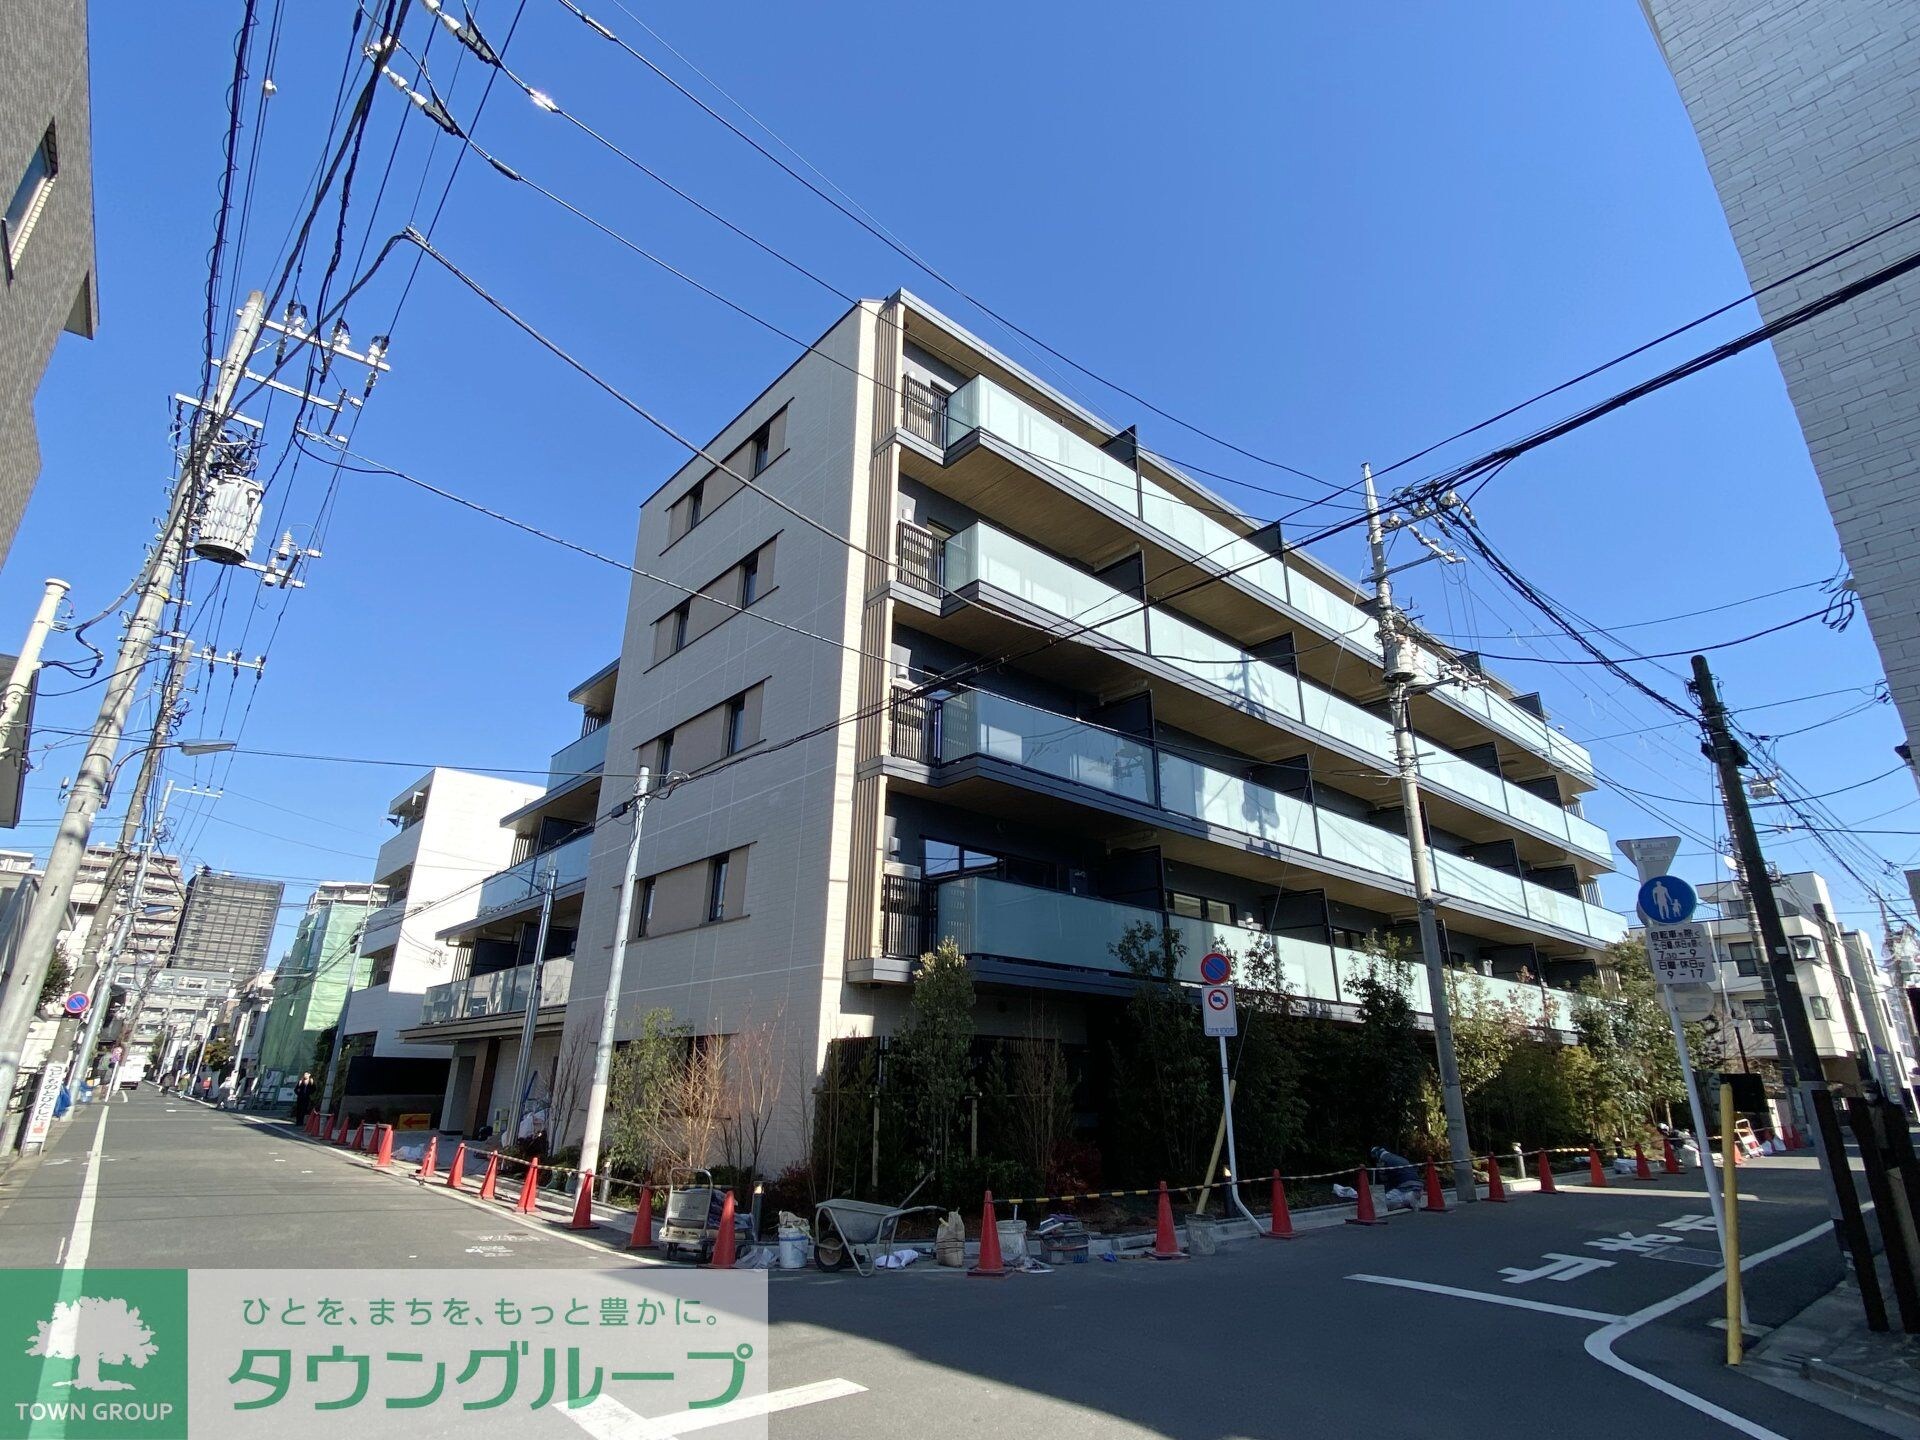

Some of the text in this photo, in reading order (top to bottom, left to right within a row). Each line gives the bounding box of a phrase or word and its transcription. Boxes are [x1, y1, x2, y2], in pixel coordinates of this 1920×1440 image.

[1650, 928, 1701, 941] 自転車を除く
